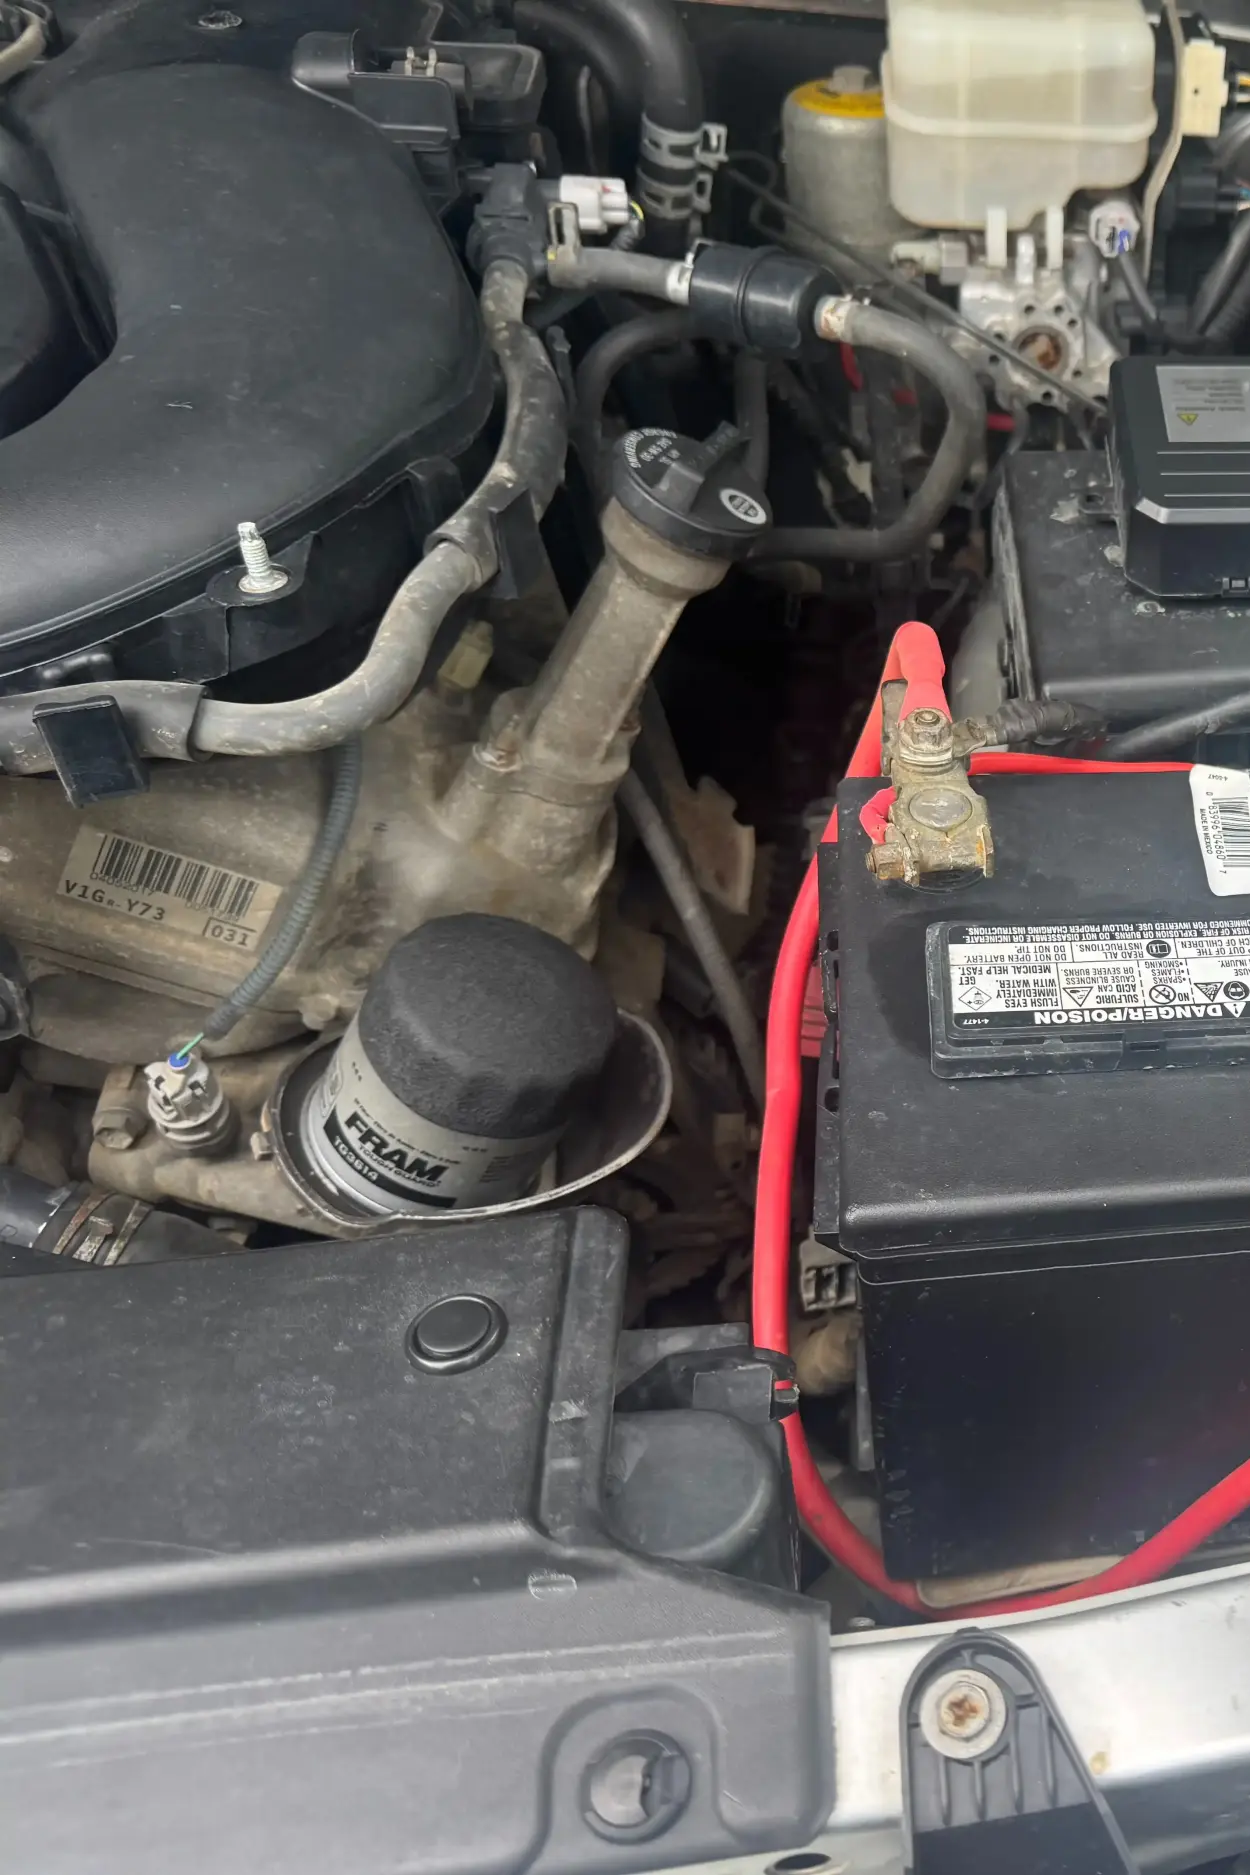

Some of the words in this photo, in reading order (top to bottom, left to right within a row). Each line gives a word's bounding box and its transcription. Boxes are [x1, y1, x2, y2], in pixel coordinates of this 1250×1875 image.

[1200, 808, 1209, 824] MADE
[1208, 805, 1221, 830] 83996
[1203, 832, 1214, 855] MEXICO
[1212, 834, 1227, 860] 04860
[1026, 925, 1068, 935] CHARGING
[1068, 925, 1101, 934] PROPER
[1102, 923, 1134, 933] FOLLOW
[1135, 923, 1154, 932] USE.
[1153, 922, 1191, 931] INVERTED
[1191, 921, 1209, 930] FOR
[964, 926, 1026, 936] INSTRUCTIONS.
[1111, 931, 1142, 940] BURNS.
[1155, 929, 1198, 939] EXPLOSION
[1232, 927, 1250, 936] RISK
[210, 924, 249, 948] 031
[961, 935, 1011, 944] INCINERATE.
[1025, 933, 1078, 942] DISASSEMBLE
[1079, 933, 1098, 941] NOT
[1075, 941, 1144, 952] INSTRUCTIONS.
[1177, 940, 1223, 949] CHILDREN.
[1014, 945, 1031, 954] TIP.
[1033, 945, 1051, 954] NOT
[1195, 947, 1213, 956] THE
[1228, 946, 1246, 955] OUT
[963, 955, 1005, 964] BATTERY.
[1007, 954, 1031, 963] OPEN
[1034, 953, 1052, 962] NOT
[1102, 951, 1119, 960] ALL
[1120, 950, 1145, 960] READ
[1217, 959, 1247, 968] INJURY.
[957, 966, 983, 976] FAST.
[986, 965, 1009, 976] HELP
[1010, 964, 1052, 975] MEDICAL
[1060, 968, 1090, 977] BURNS.
[1092, 968, 1121, 976] SEVERE
[958, 976, 977, 985] GET
[1033, 978, 1057, 988] WITH
[1065, 976, 1108, 985] BLINDNESS
[1110, 975, 1136, 983] CAUSE
[995, 979, 1030, 989] WATER.
[1097, 984, 1114, 993] CAN
[1116, 983, 1137, 993] ACID
[995, 988, 1058, 999] IMMEDIATELY
[1178, 993, 1190, 1002] NO
[1004, 999, 1027, 1009] EYES
[1030, 998, 1059, 1007] FLUSH
[1095, 994, 1139, 1005] SULFURIC
[1033, 1004, 1223, 1025] DANGER/POISON
[962, 1018, 990, 1026] 4-1477
[344, 1111, 451, 1183] FRAM
